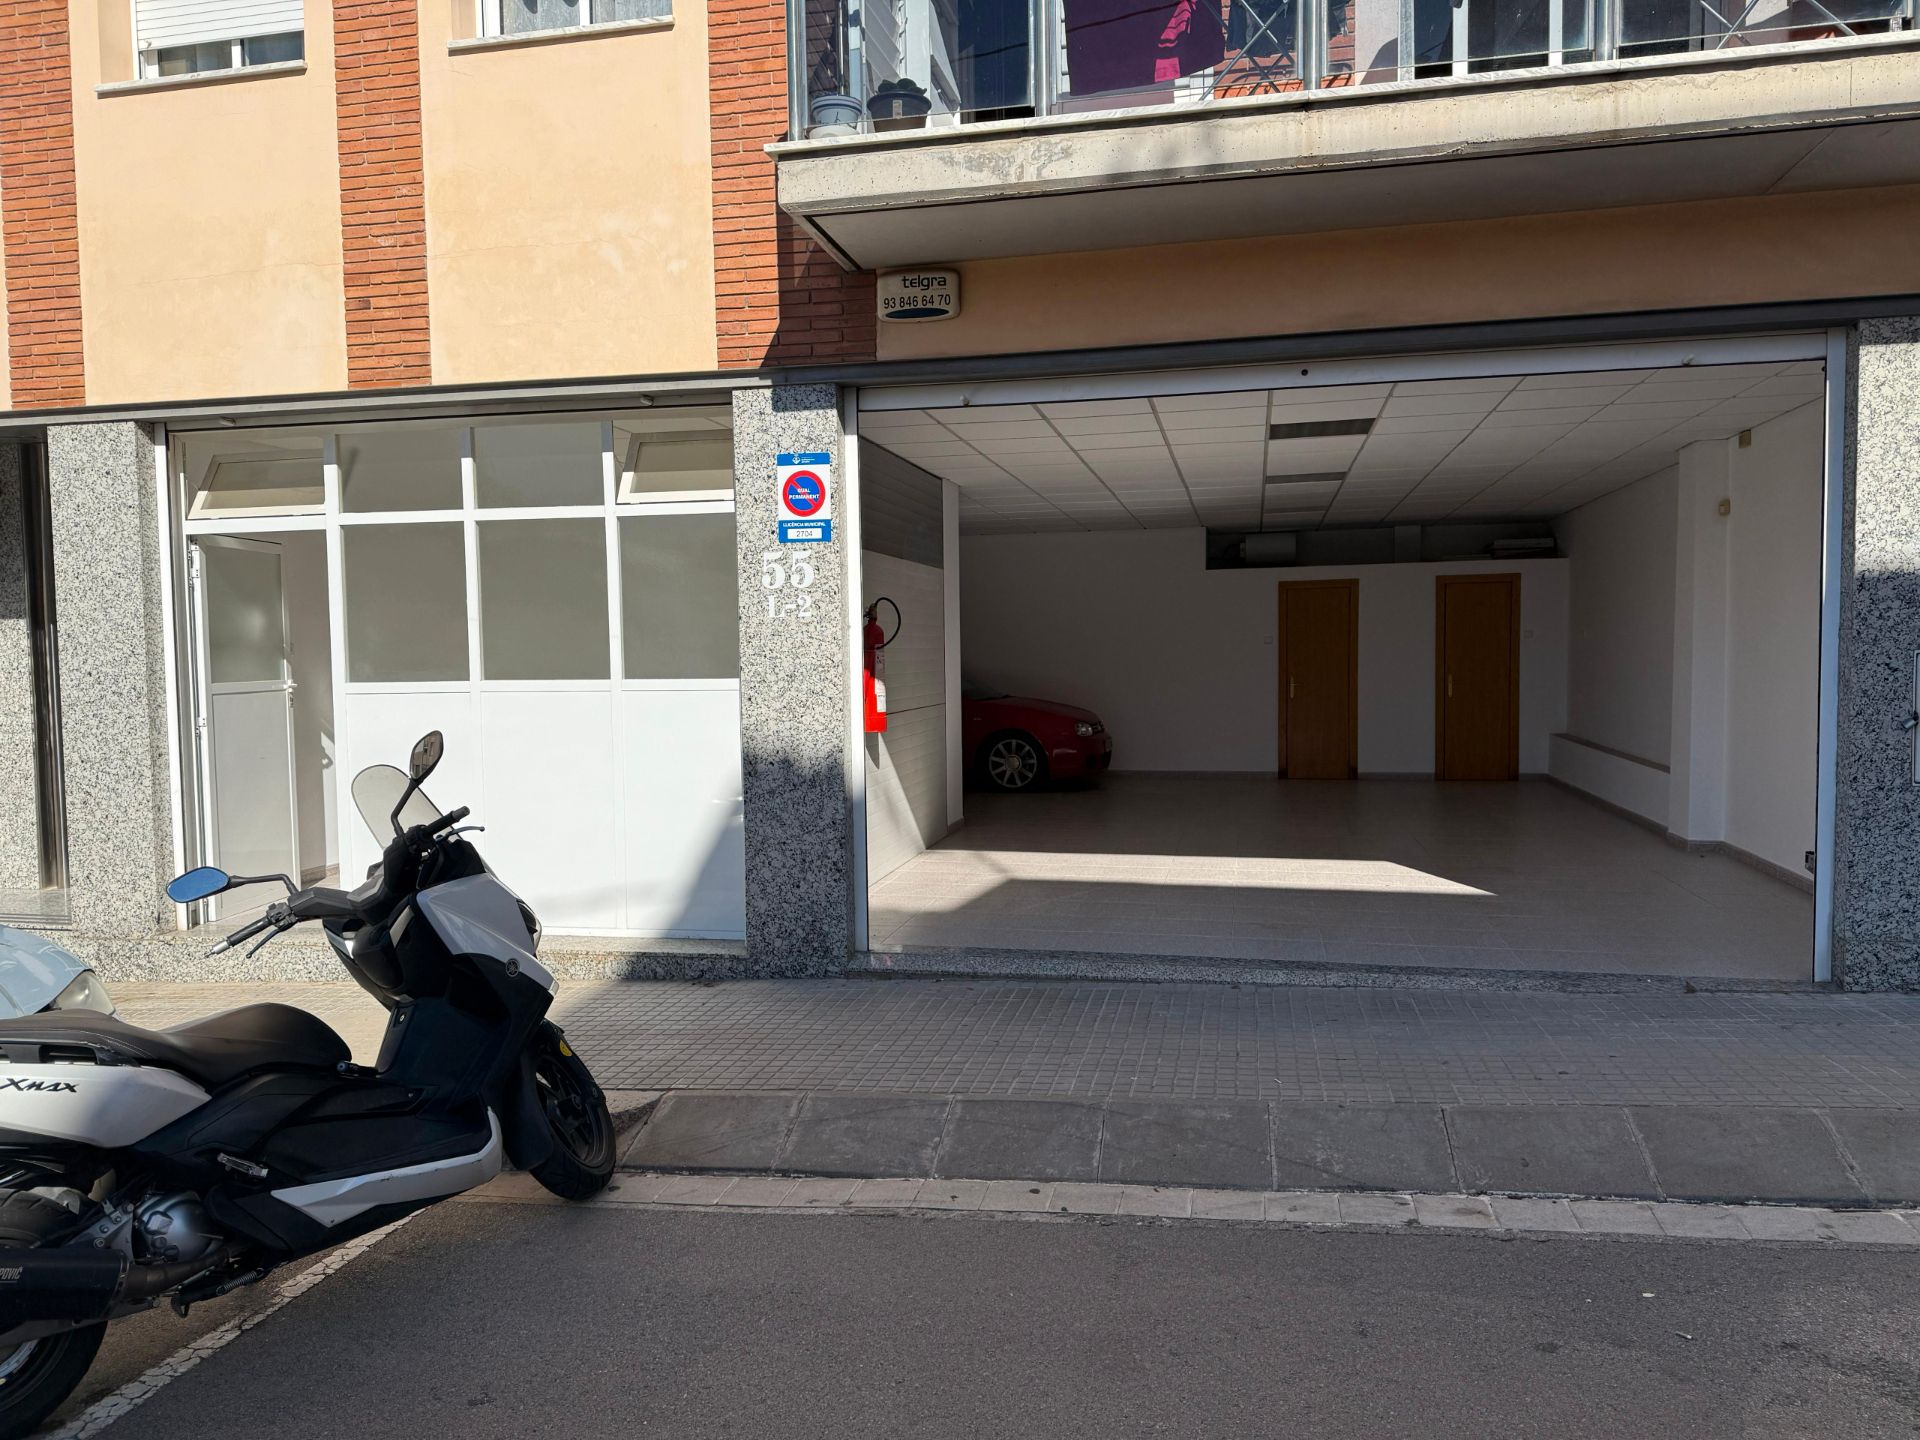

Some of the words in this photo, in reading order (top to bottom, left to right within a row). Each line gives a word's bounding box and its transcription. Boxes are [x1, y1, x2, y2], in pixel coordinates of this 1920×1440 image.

[901, 275, 947, 291] telgra
[883, 297, 896, 309] 93
[899, 295, 919, 308] 846
[921, 294, 935, 307] 64
[937, 293, 951, 306] 70
[761, 549, 815, 589] 55
[766, 594, 812, 618] L-2
